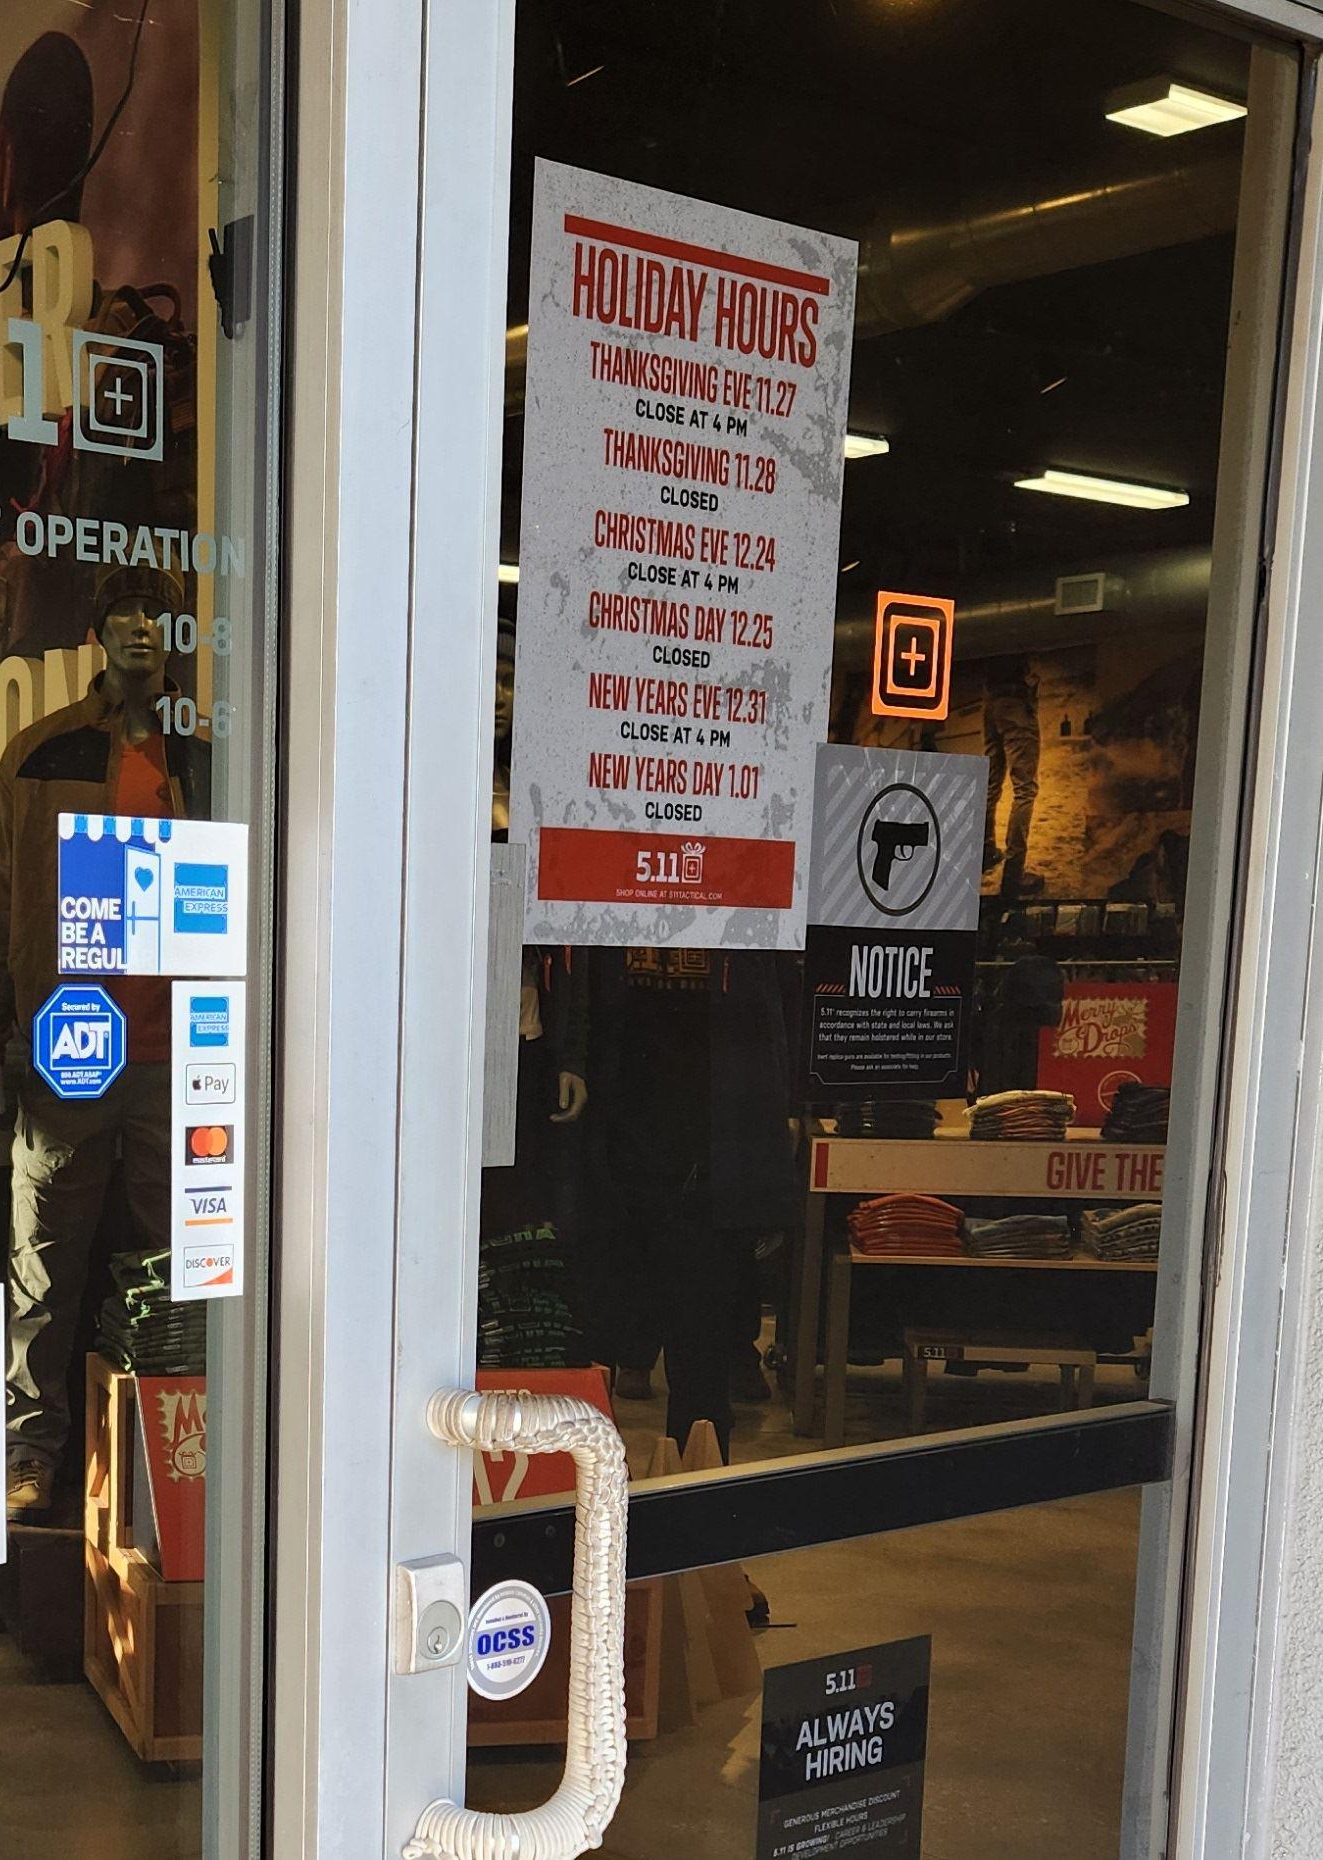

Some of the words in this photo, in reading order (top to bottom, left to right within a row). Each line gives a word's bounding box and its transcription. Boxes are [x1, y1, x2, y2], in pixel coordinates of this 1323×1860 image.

[572, 242, 708, 343] HOLIDAY
[715, 277, 819, 368] HOURS
[590, 341, 719, 404] THANKSGIVING
[723, 369, 752, 413] EVE
[756, 376, 797, 418] 11.27
[635, 399, 685, 426] CLOSE
[690, 409, 708, 429] AT
[712, 414, 722, 432] 4
[727, 416, 748, 437] PM
[604, 428, 730, 487] THANKSGIVING
[735, 452, 776, 495] 11.28
[660, 486, 719, 512] CLOSED
[16, 511, 246, 579] OPERATION
[594, 509, 696, 561] CHRISTMAS
[700, 527, 729, 566] EVE
[734, 532, 776, 572] 12.24
[628, 562, 677, 586] CLOSE
[681, 570, 701, 589] AT
[704, 573, 713, 591] 4
[718, 574, 739, 594] PM
[155, 613, 232, 655] 10-8
[589, 591, 689, 640] CHRISTMAS
[695, 605, 727, 645] DAY
[731, 609, 773, 650] 12.25
[653, 645, 711, 669] CLOSED
[589, 672, 632, 712] NEW
[636, 676, 688, 720] YEARS
[693, 683, 722, 721] EVE
[726, 687, 767, 725] 12.31
[155, 695, 233, 739] 10-6
[620, 721, 669, 743] CLOSE
[673, 727, 692, 745] AT
[696, 729, 705, 746] 4
[710, 729, 731, 748] PM
[589, 752, 631, 790] NEW
[635, 755, 688, 795] YEARS
[692, 760, 724, 798] DAY
[728, 765, 759, 800] 1.01
[645, 801, 703, 822] CLOSED
[636, 850, 680, 883] 5.11
[60, 896, 122, 921] COME
[174, 887, 224, 898] AMERICAN
[185, 902, 229, 913] EXPRESS
[61, 923, 88, 944] BE
[90, 923, 106, 944] A
[849, 945, 934, 998] NOTICE
[61, 1002, 90, 1011] Secured
[91, 1002, 100, 1012] by
[190, 1013, 227, 1021] AMERICAN
[836, 1009, 869, 1018] recognizes
[870, 1009, 881, 1017] the
[883, 1009, 897, 1018] right
[898, 1009, 905, 1017] to
[906, 1010, 922, 1018] carry
[923, 1009, 947, 1017] firearms
[1060, 996, 1118, 1033] Merry
[52, 1021, 111, 1060] ADT
[197, 1024, 229, 1033] EXPRESS
[818, 1033, 832, 1041] that
[833, 1033, 848, 1043] they
[871, 1033, 900, 1041] holstered
[901, 1033, 916, 1041] while
[918, 1033, 924, 1041] in
[819, 1021, 855, 1029] accordance
[856, 1021, 869, 1029] with
[871, 1021, 887, 1029] state
[888, 1021, 900, 1029] and
[901, 1021, 915, 1029] local
[933, 1021, 942, 1029] We
[944, 1021, 954, 1029] ask
[1076, 1021, 1137, 1054] Drops
[204, 1075, 229, 1094] Pay
[1047, 1151, 1107, 1191] GIVE
[1115, 1153, 1164, 1193] THE
[192, 1197, 227, 1214] VISA
[185, 1256, 231, 1269] DISCOVER
[477, 1625, 535, 1655] OCSS
[825, 1668, 856, 1695] 5.11
[796, 1702, 895, 1750] ALWAYS
[805, 1736, 884, 1781] HIRING
[783, 1812, 820, 1829] GENEROUS
[821, 1799, 867, 1818] MERCHANDISE
[868, 1790, 901, 1806] DISCOUNT
[814, 1817, 844, 1834] FLEXIBLE
